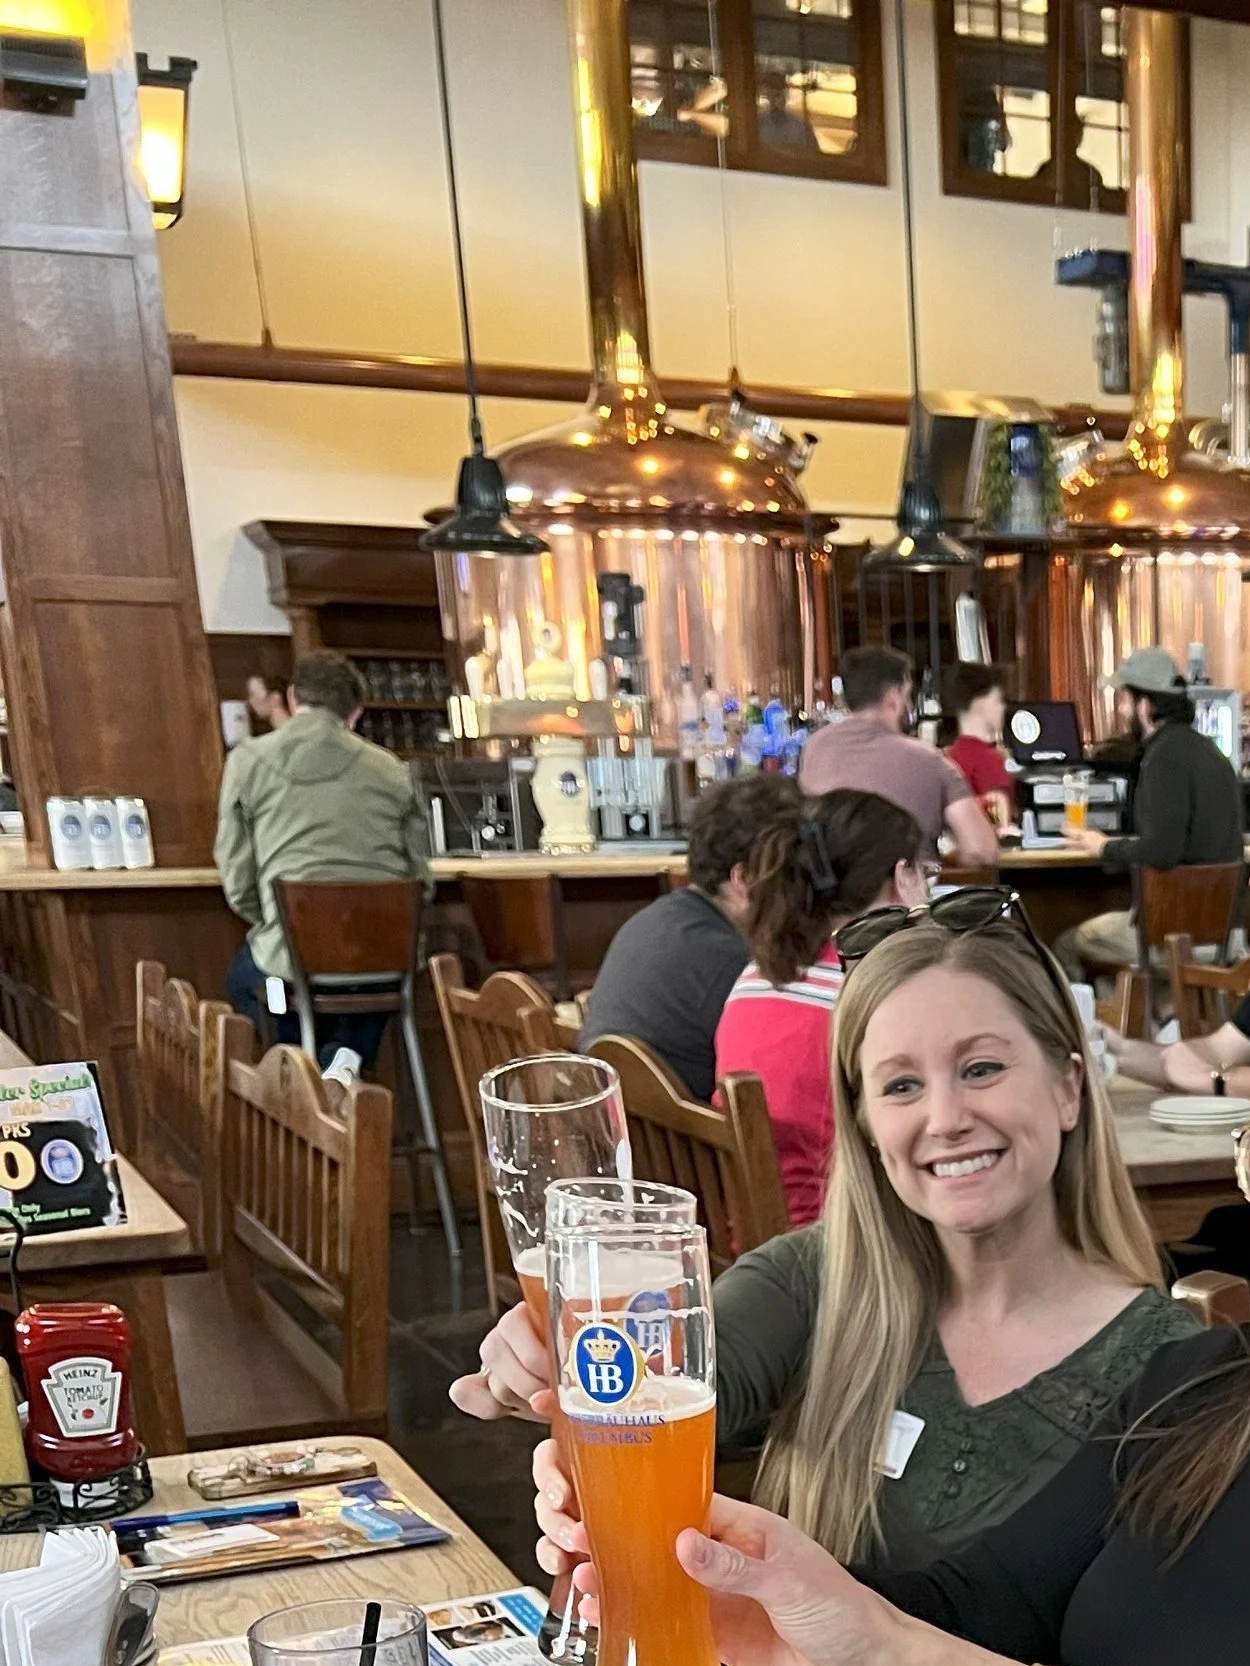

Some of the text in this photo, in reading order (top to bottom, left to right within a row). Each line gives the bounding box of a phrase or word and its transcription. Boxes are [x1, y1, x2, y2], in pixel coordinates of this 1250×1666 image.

[2, 1122, 32, 1139] PKS
[63, 1368, 99, 1381] HEINZ
[586, 1363, 625, 1394] HB
